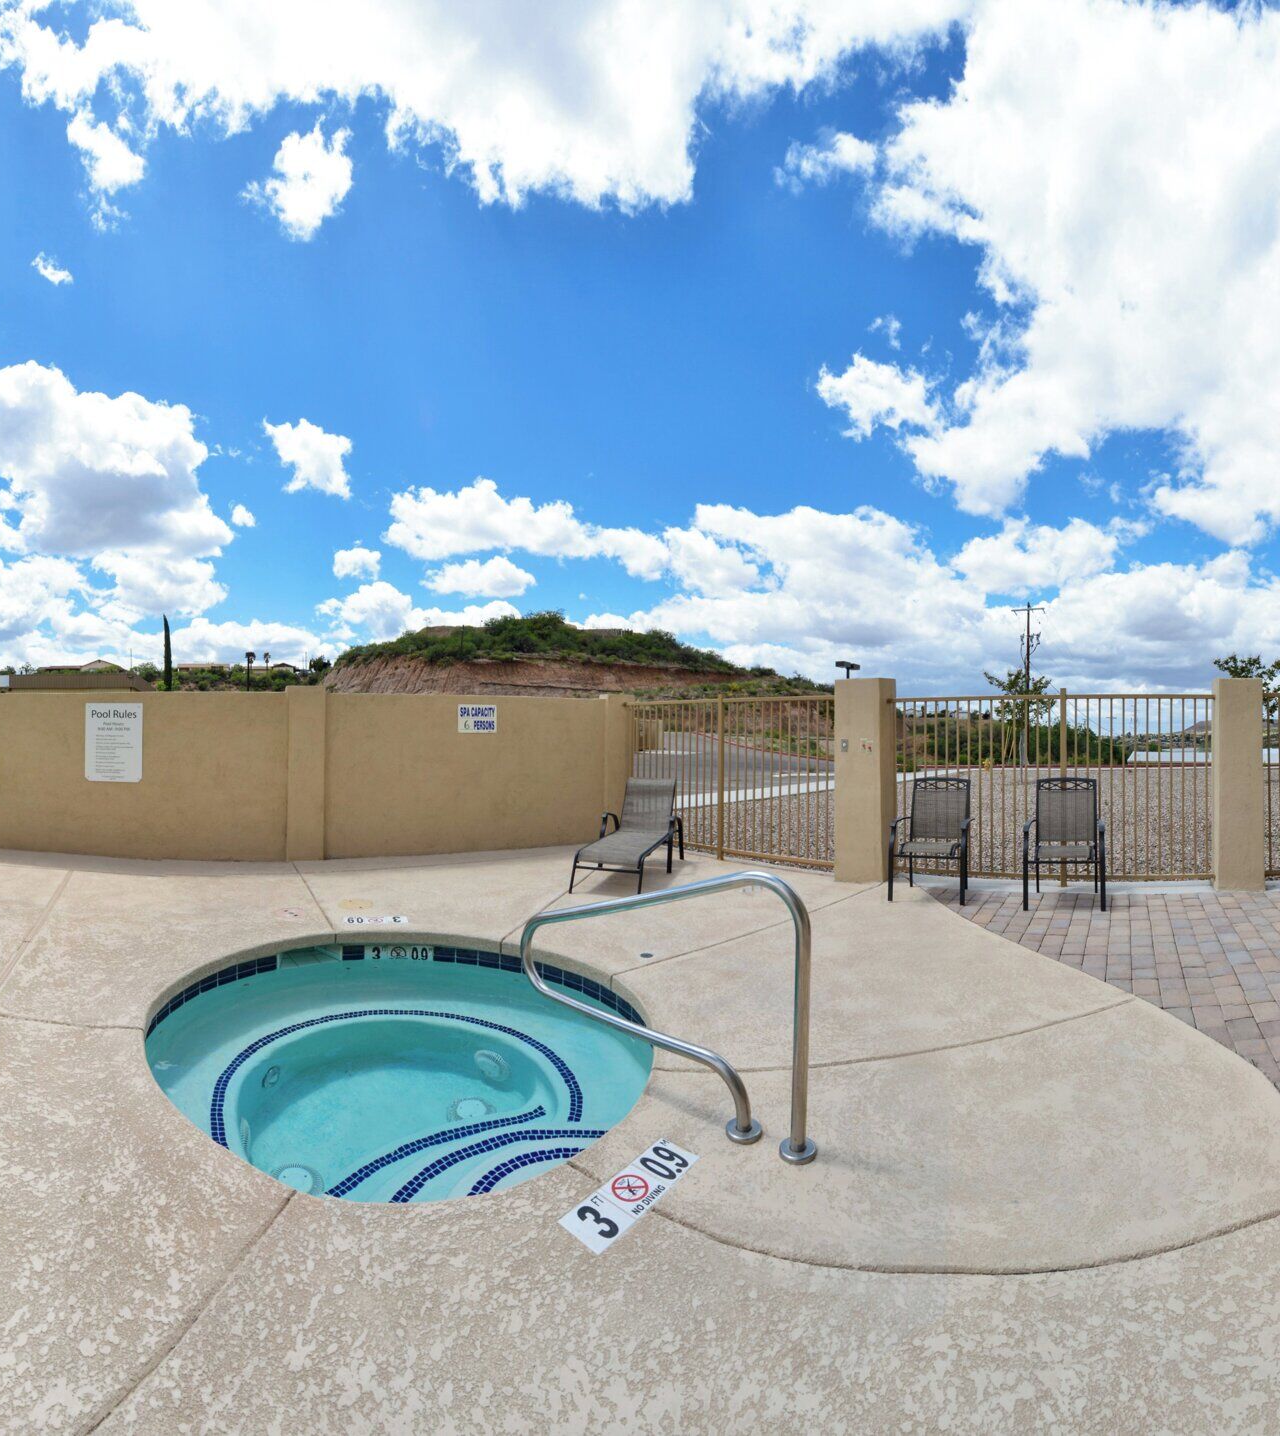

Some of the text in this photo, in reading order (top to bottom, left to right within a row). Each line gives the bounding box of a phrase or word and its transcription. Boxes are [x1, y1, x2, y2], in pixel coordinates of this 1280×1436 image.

[91, 709, 137, 719] Pool Rules
[460, 706, 495, 717] SPA CAPACITY
[463, 719, 495, 730] 6 PERSONS
[372, 946, 381, 960] 3
[411, 946, 428, 961] 0.9
[639, 1146, 689, 1180] 0.9
[590, 1195, 604, 1207] FT
[631, 1184, 666, 1216] NO DIVING
[576, 1205, 620, 1240] 3
